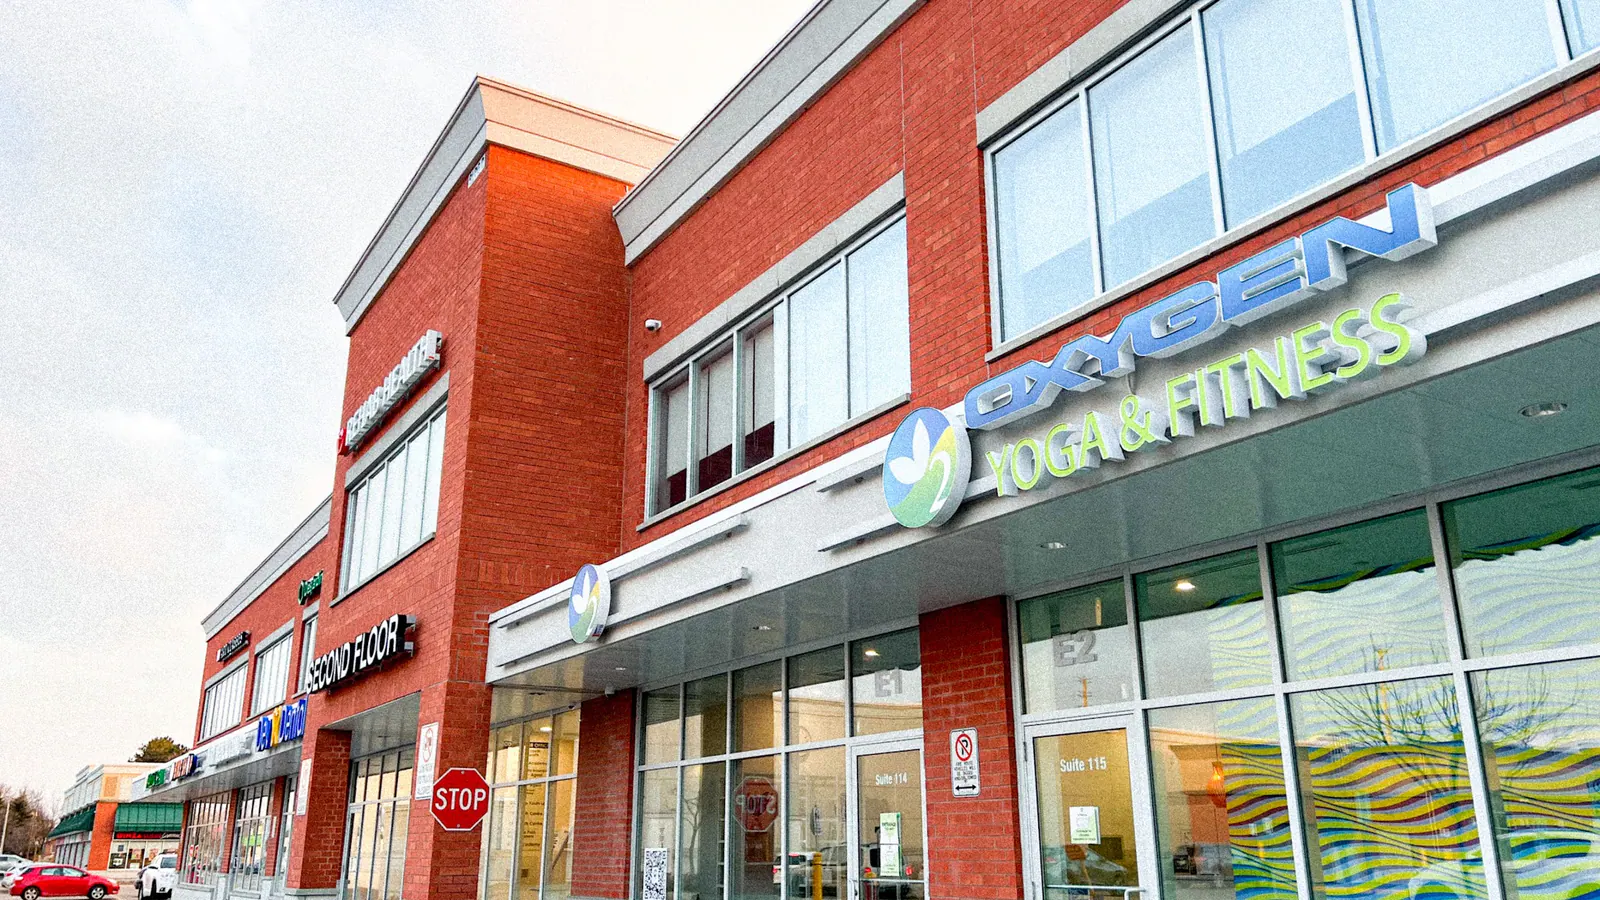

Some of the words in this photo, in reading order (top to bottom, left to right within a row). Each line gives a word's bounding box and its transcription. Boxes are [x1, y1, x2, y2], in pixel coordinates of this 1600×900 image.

[964, 183, 1428, 429] OXYGEN
[985, 411, 1111, 497] YOGA
[1119, 394, 1157, 451] &
[1165, 292, 1413, 437] FITNESS
[305, 641, 351, 694] SECOND
[352, 613, 399, 674] FLOOR
[1053, 629, 1098, 668] E2
[874, 667, 903, 698] E1
[875, 773, 893, 786] Suite
[894, 772, 908, 784] 114
[1060, 758, 1085, 773] Suite
[1088, 757, 1107, 771] 115
[434, 787, 487, 811] STOP
